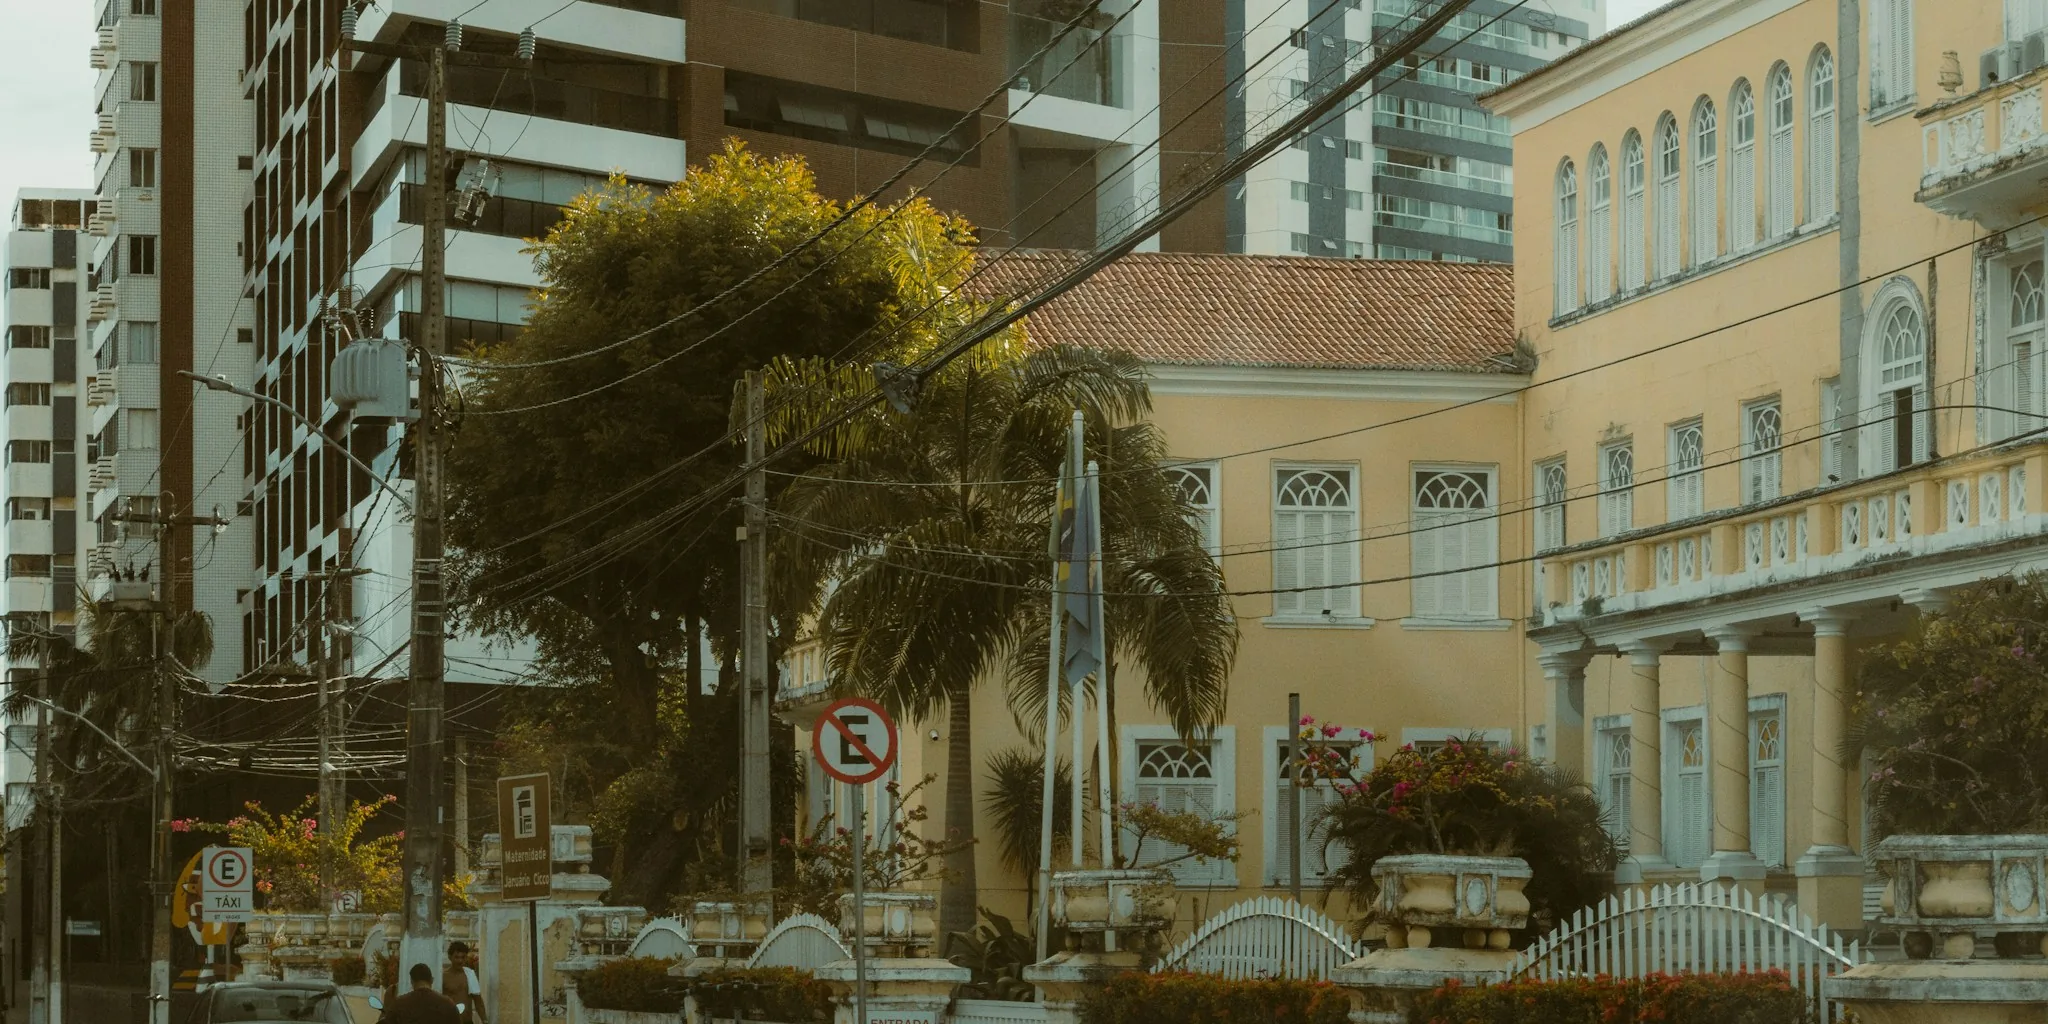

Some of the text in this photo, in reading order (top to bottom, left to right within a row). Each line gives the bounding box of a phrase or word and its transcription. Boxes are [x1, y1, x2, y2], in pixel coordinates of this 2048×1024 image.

[839, 715, 870, 765] E
[504, 847, 547, 863] Maternidade
[221, 859, 235, 879] E
[504, 872, 549, 888] Januário Cicco
